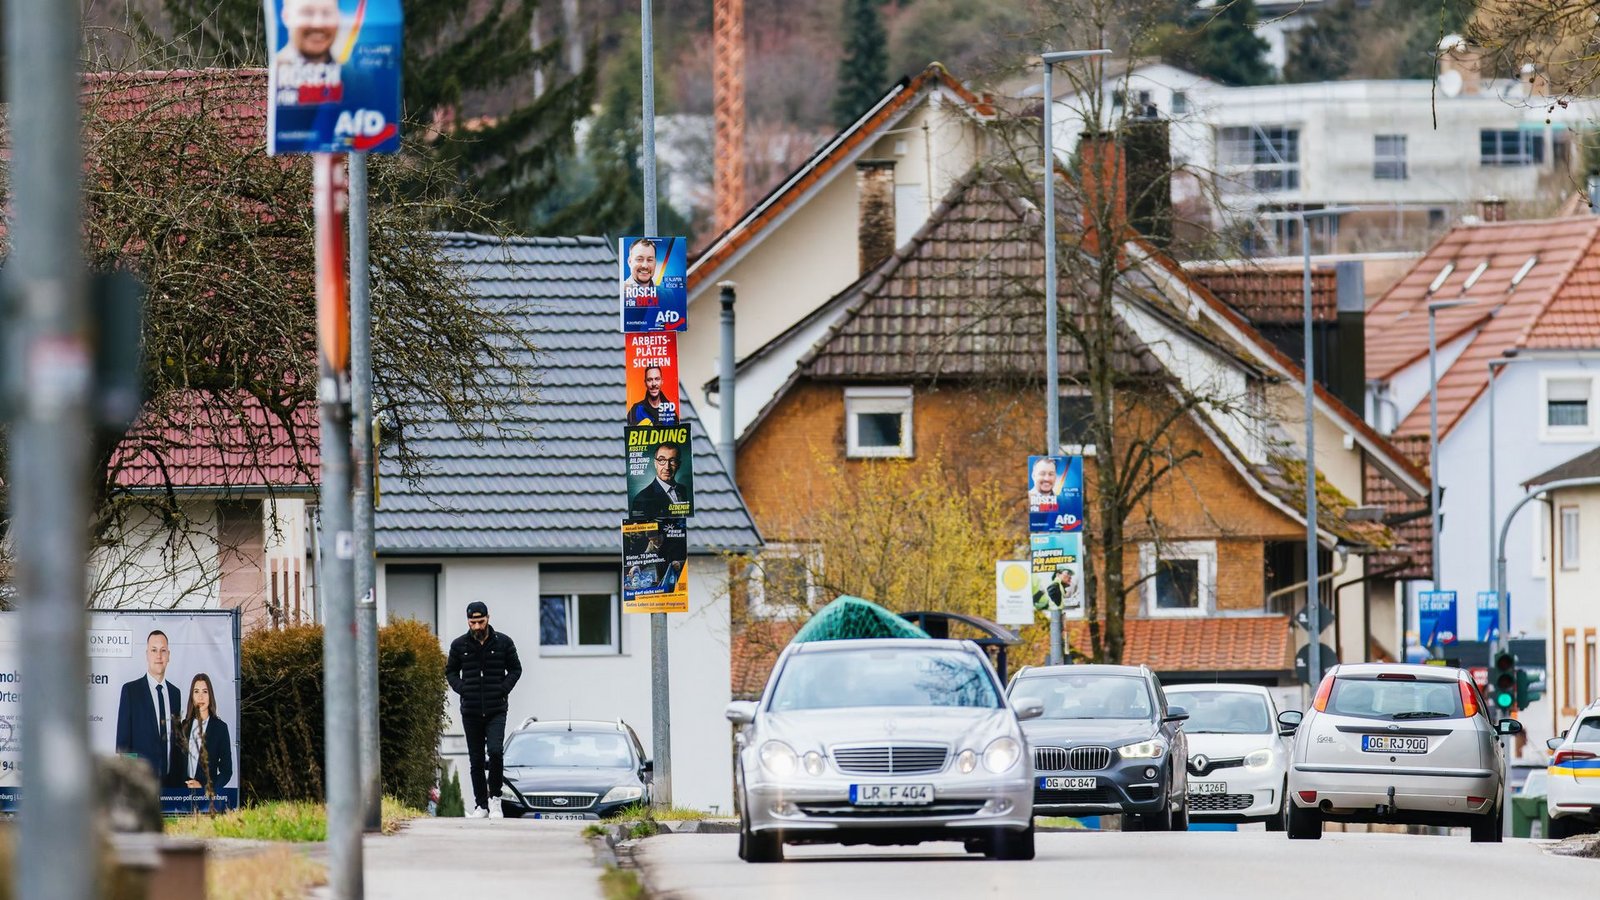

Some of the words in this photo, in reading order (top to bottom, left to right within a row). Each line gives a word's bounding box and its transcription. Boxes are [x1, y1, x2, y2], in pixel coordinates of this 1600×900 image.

[335, 108, 385, 137] AfD
[626, 285, 657, 298] RÖSCH
[626, 298, 636, 307] FÜR
[655, 310, 680, 323] AfD
[632, 336, 671, 346] ARBEITS-
[635, 345, 668, 357] PLÄTZE
[633, 357, 671, 368] SICHERN
[658, 402, 676, 412] SPD
[628, 428, 688, 446] BILDUNG
[1055, 513, 1077, 524] AfD
[90, 635, 104, 644] ON
[107, 636, 130, 645] POLL
[91, 673, 109, 685] ten
[1369, 737, 1383, 748] OG
[1390, 738, 1404, 749] RJ
[1406, 739, 1426, 749] 900
[1046, 778, 1059, 788] OG
[1064, 778, 1076, 788] OC
[1077, 778, 1095, 788] 847
[863, 786, 880, 800] LR
[889, 786, 898, 799] F
[901, 786, 926, 799] 404
